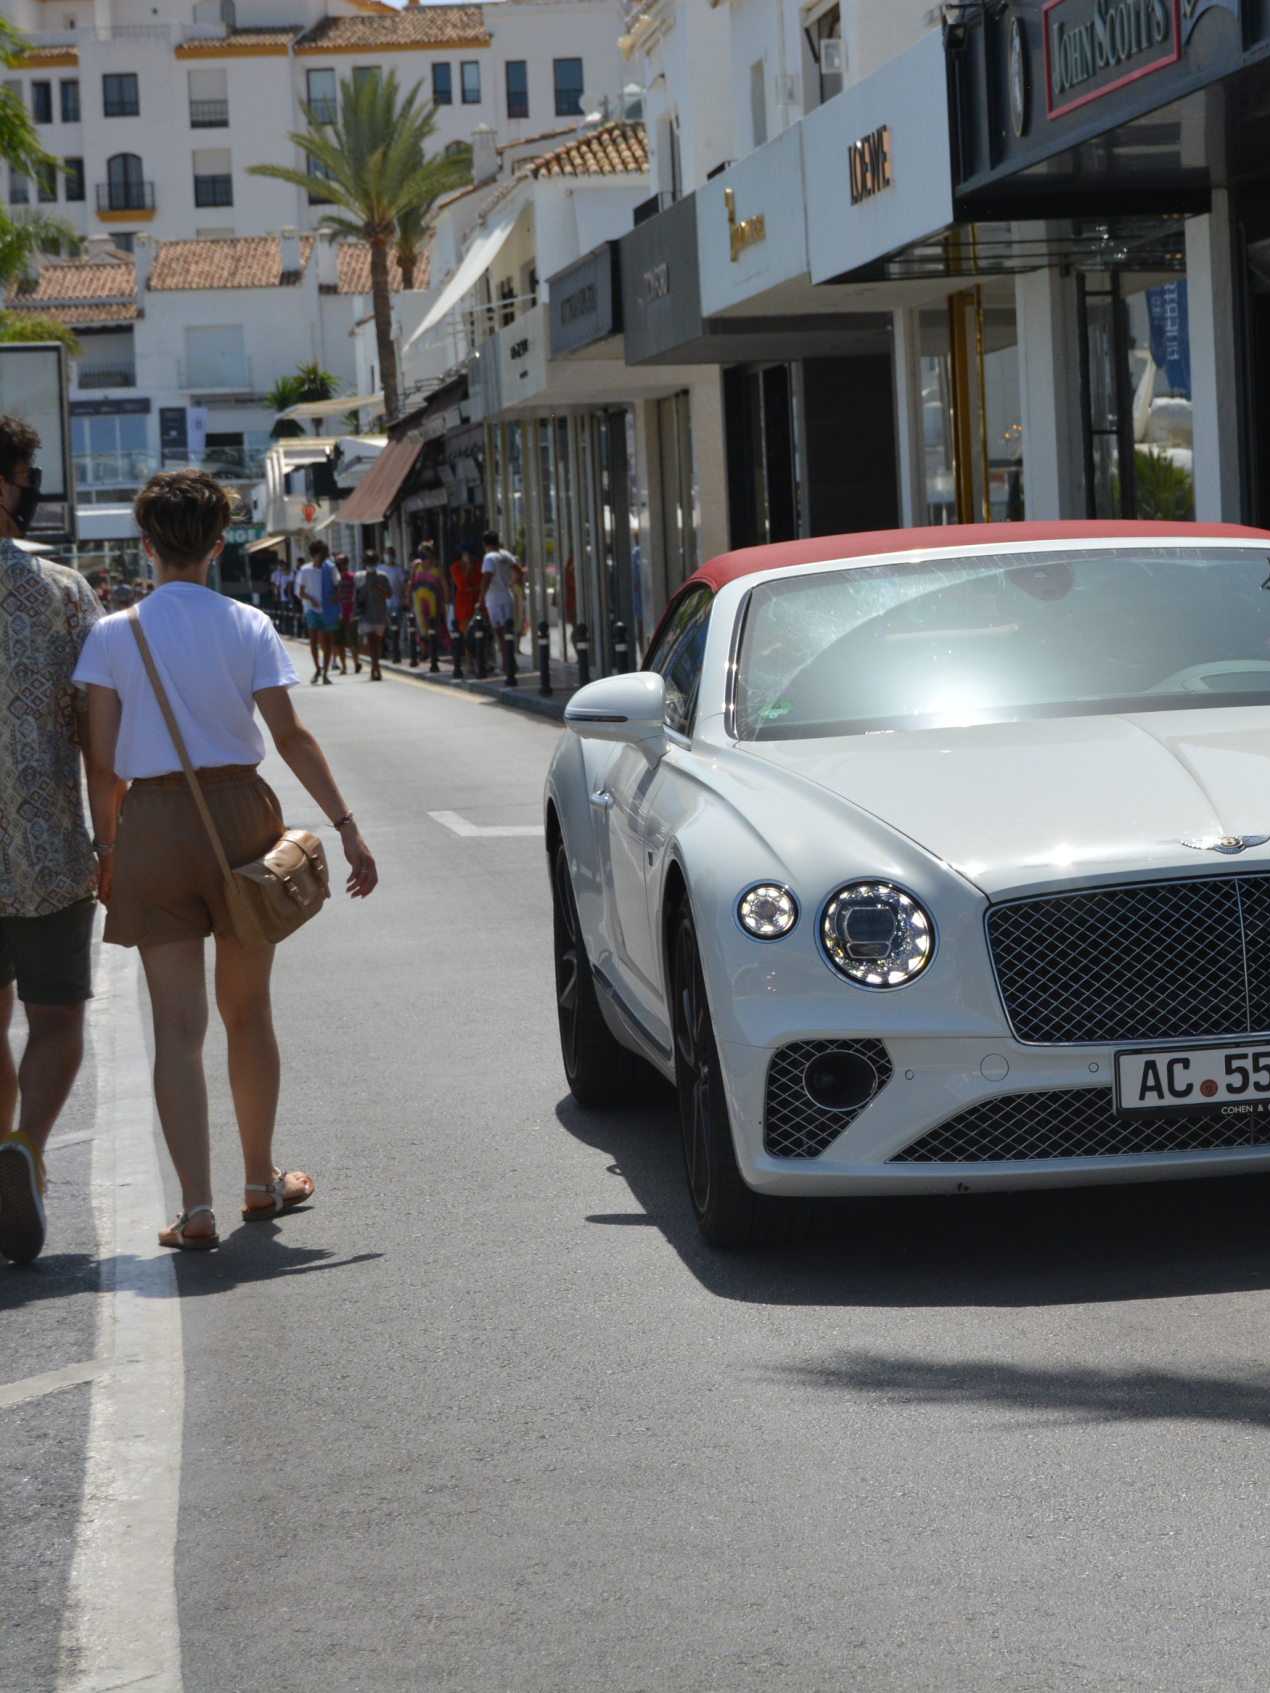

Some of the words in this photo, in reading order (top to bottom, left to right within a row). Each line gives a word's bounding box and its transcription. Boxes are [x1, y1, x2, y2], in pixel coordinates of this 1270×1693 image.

[1052, 21, 1096, 95] JOHN
[847, 123, 893, 207] LOEWE
[1138, 1056, 1195, 1101] AC
[1221, 1105, 1253, 1115] COHEN
[1257, 1104, 1264, 1112] &
